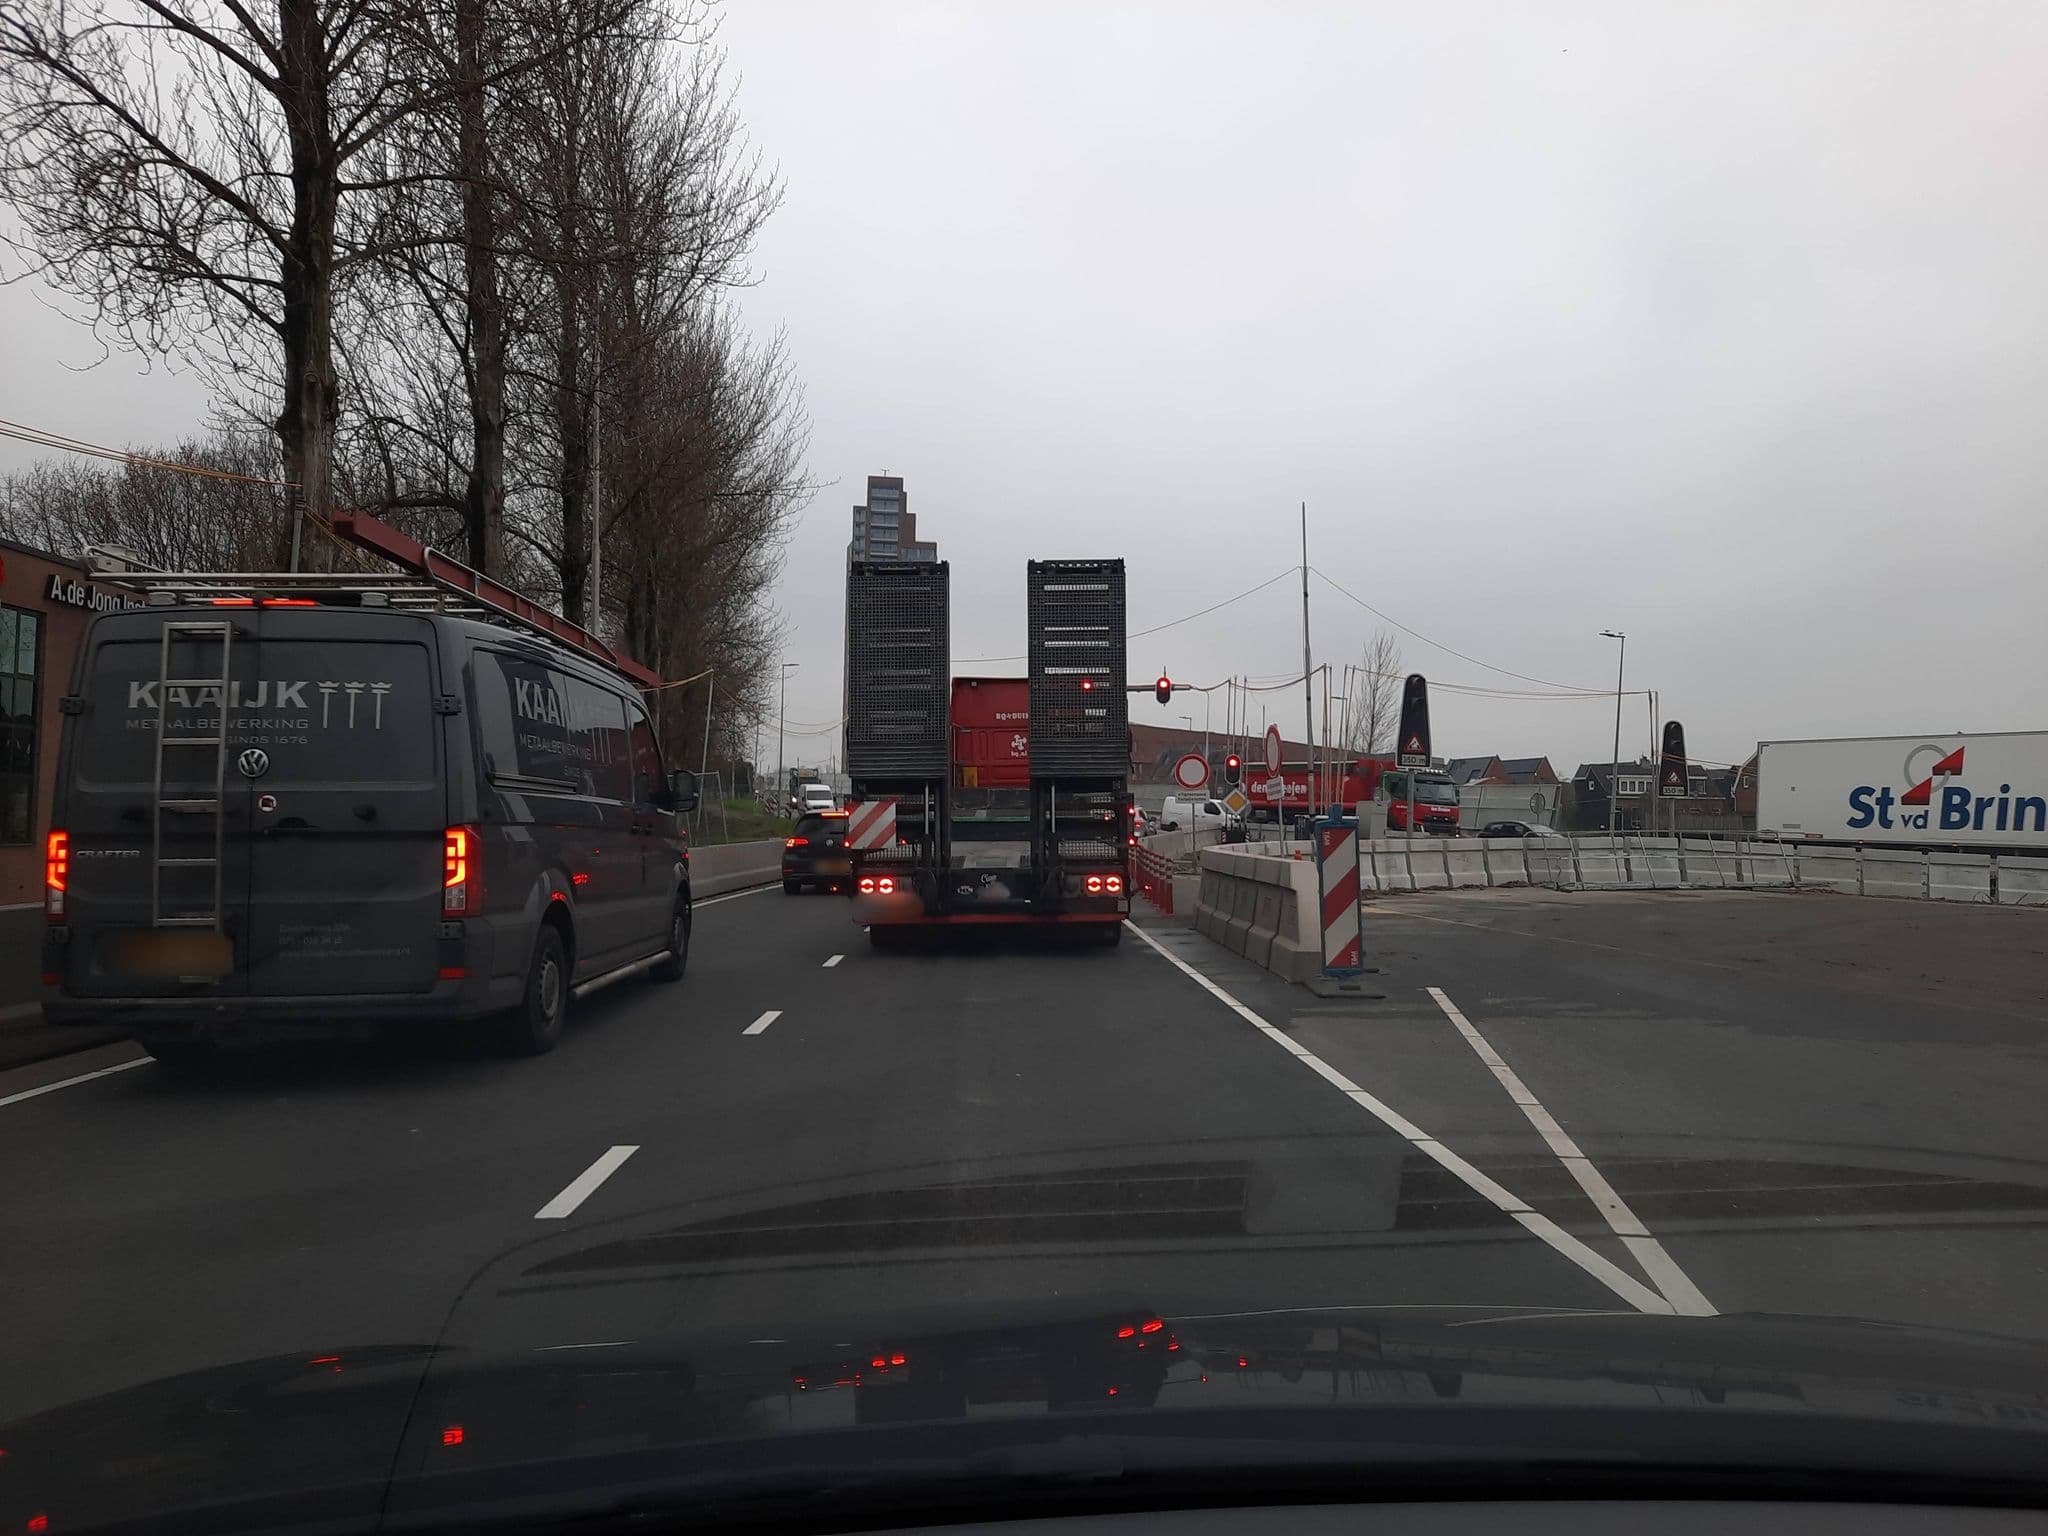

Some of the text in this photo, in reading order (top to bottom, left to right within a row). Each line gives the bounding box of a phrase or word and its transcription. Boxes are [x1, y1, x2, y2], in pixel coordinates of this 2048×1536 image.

[127, 680, 310, 709] KAAIJK
[226, 735, 269, 745] SINDS
[1250, 781, 1267, 793] den
[1846, 783, 2047, 832] St vd Brin
